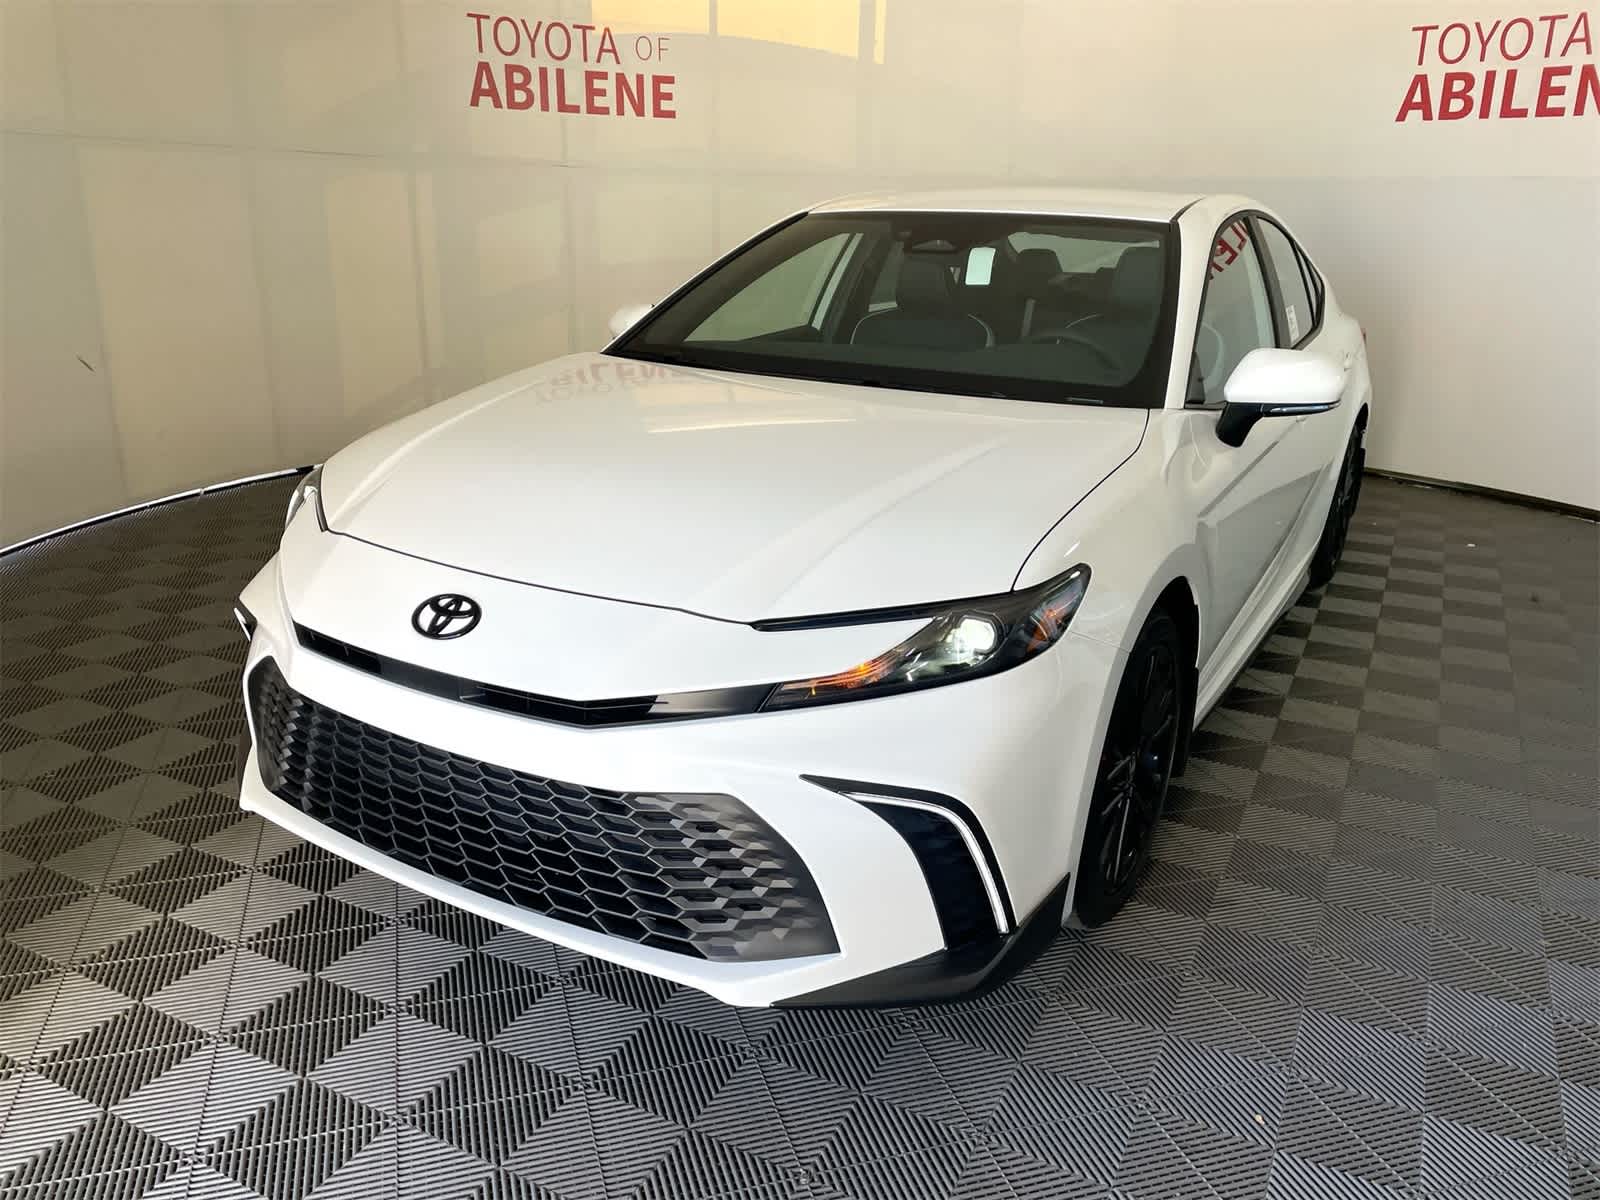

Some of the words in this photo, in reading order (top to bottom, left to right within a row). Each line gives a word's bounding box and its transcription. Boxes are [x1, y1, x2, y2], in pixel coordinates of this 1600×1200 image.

[467, 13, 621, 64] TOYOTA
[635, 36, 670, 61] OF
[1412, 12, 1592, 66] TOYOTA
[470, 61, 677, 118] ABILENE
